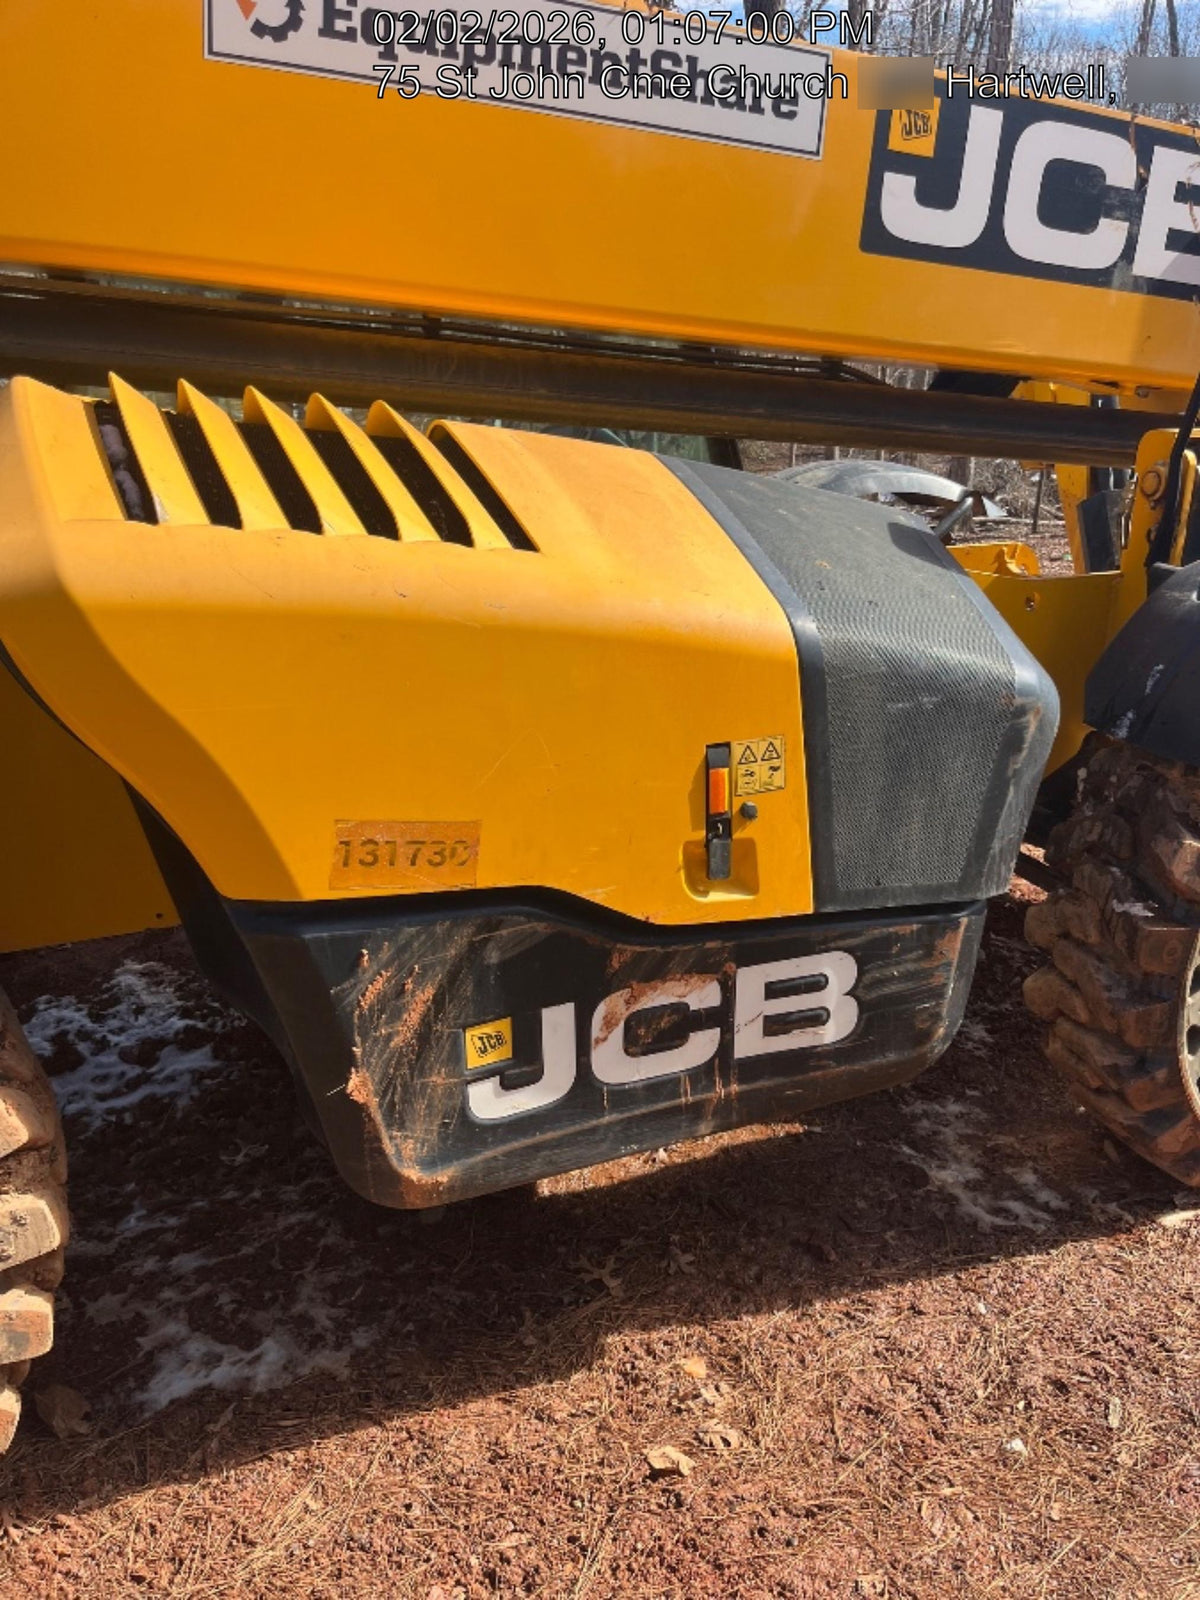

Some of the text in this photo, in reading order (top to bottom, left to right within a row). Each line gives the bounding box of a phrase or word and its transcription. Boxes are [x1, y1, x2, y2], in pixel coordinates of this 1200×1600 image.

[318, 0, 800, 121] EquipmentShare
[902, 109, 930, 136] JCB
[467, 950, 859, 1120] JCB
[477, 1034, 503, 1055] JCB
